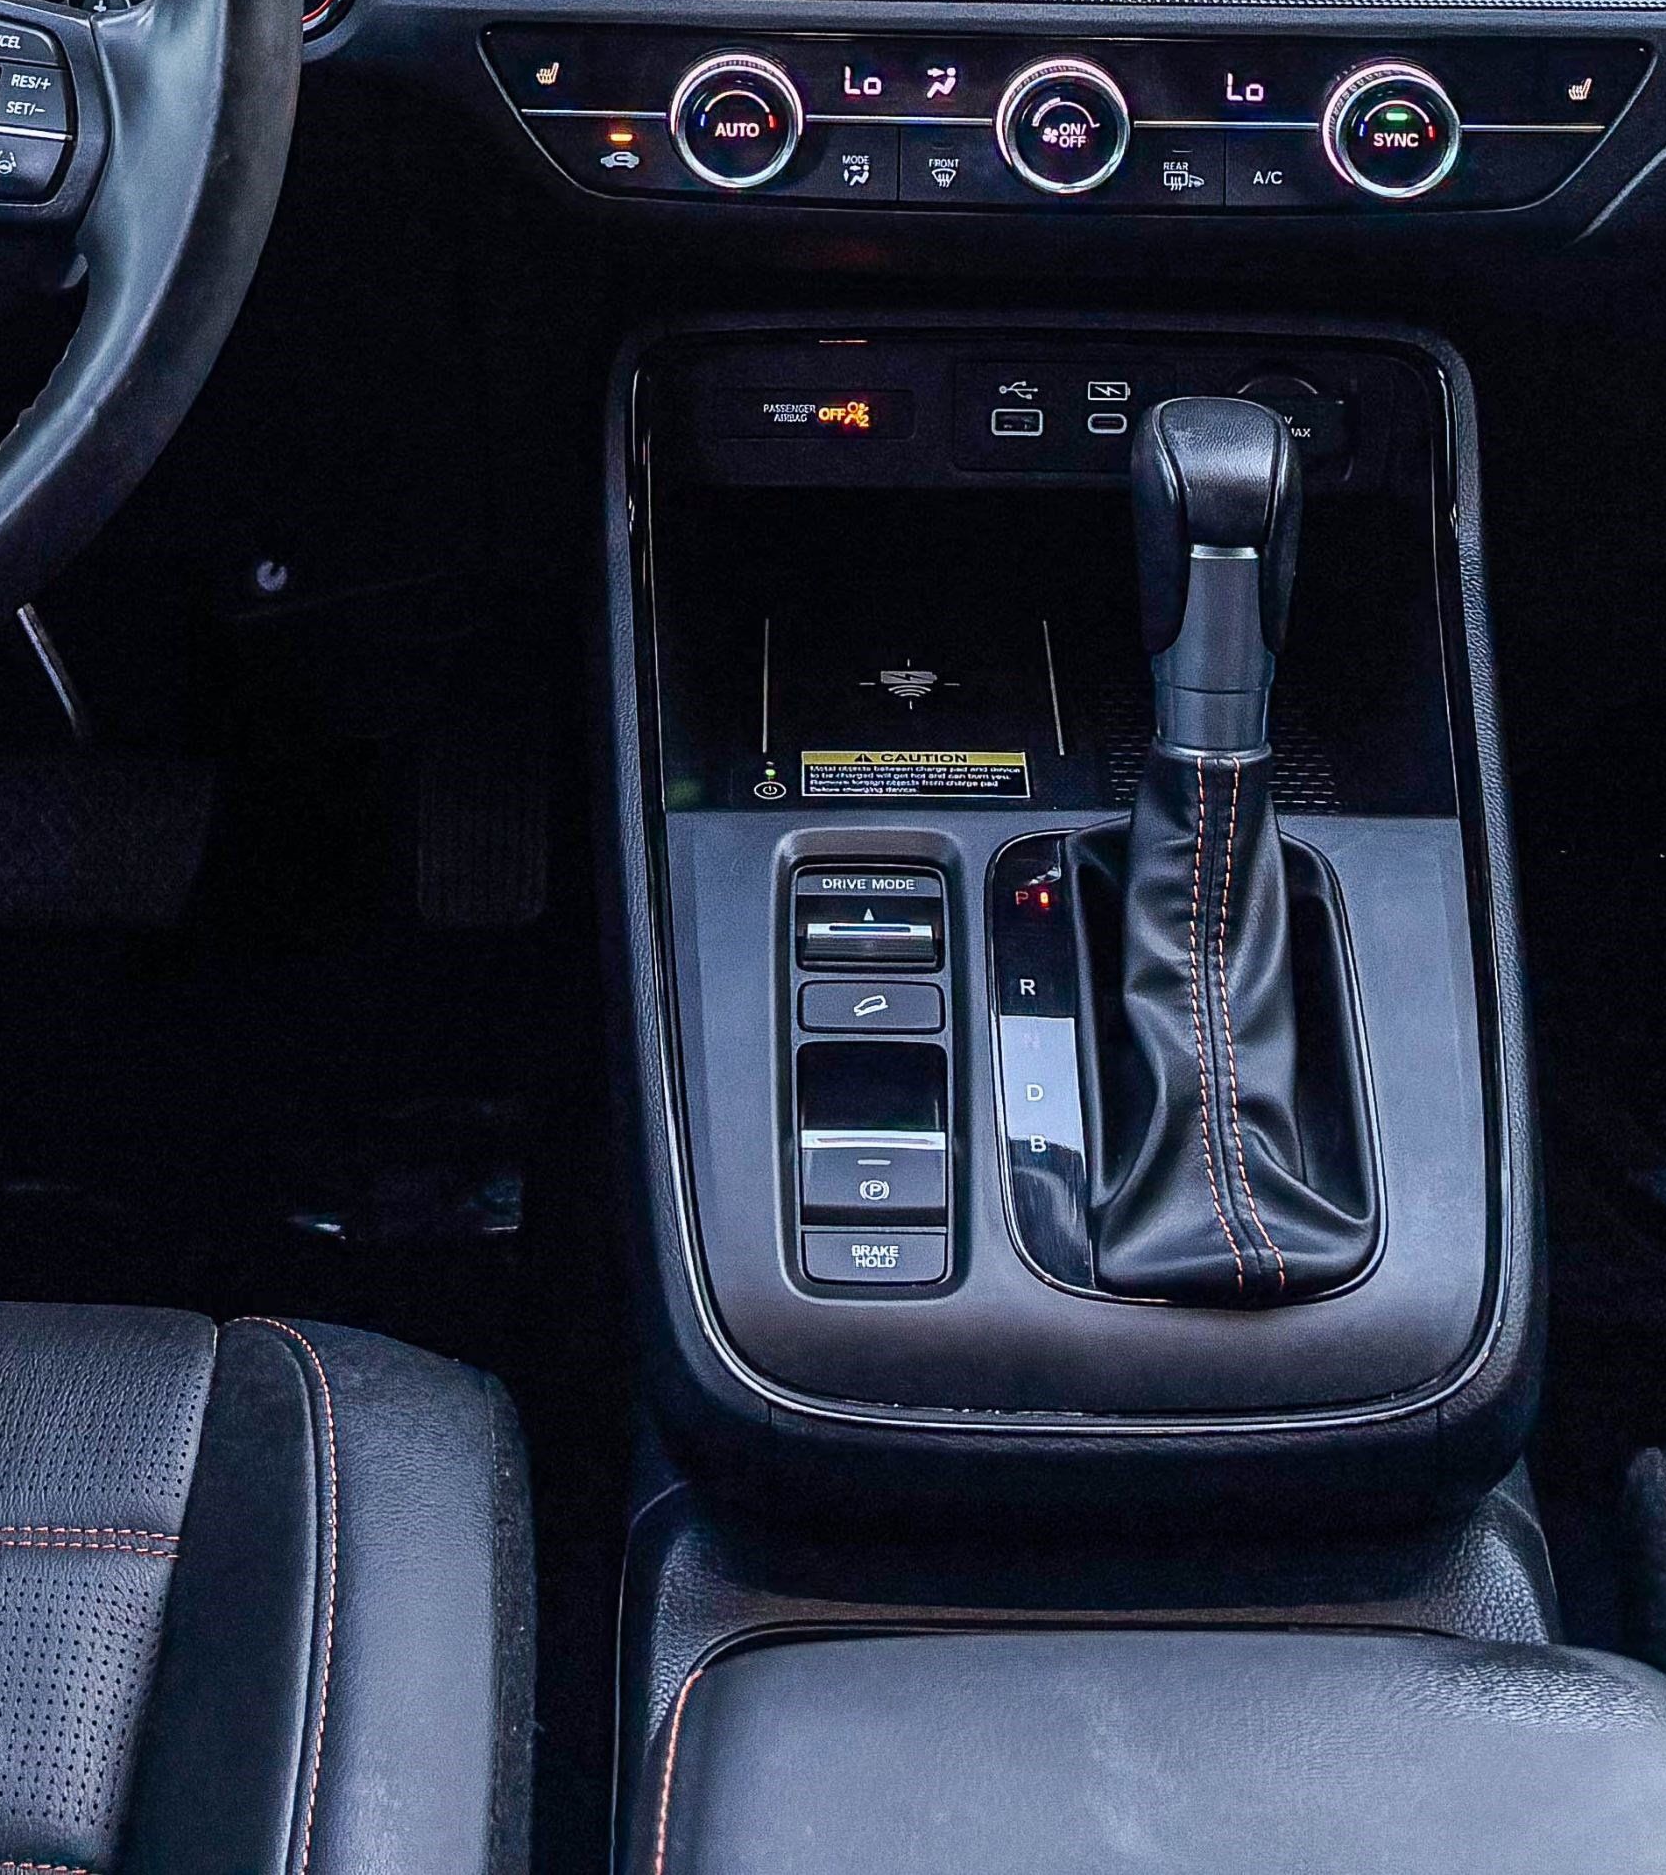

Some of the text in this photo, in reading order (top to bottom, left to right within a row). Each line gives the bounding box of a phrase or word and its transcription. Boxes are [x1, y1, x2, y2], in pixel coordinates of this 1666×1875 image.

[715, 122, 760, 138] AUTO
[1059, 124, 1087, 136] ON/
[1059, 135, 1086, 147] OFF
[1373, 133, 1419, 148] SYNC
[842, 154, 869, 164] MODE
[929, 158, 959, 168] FRONT
[1163, 162, 1189, 171] REAR
[1253, 171, 1283, 187] A/C
[763, 404, 816, 414] PASSENGER
[818, 407, 846, 421] OFF
[774, 413, 808, 423] AIRBAG
[880, 754, 967, 763] CAUTION
[822, 878, 915, 890] DRIVE MODE
[1015, 891, 1029, 905] P
[1019, 979, 1035, 996] R
[1026, 1085, 1044, 1101] D
[1030, 1136, 1047, 1153] B
[851, 1244, 899, 1258] BRAKE
[855, 1256, 896, 1268] HOLD
